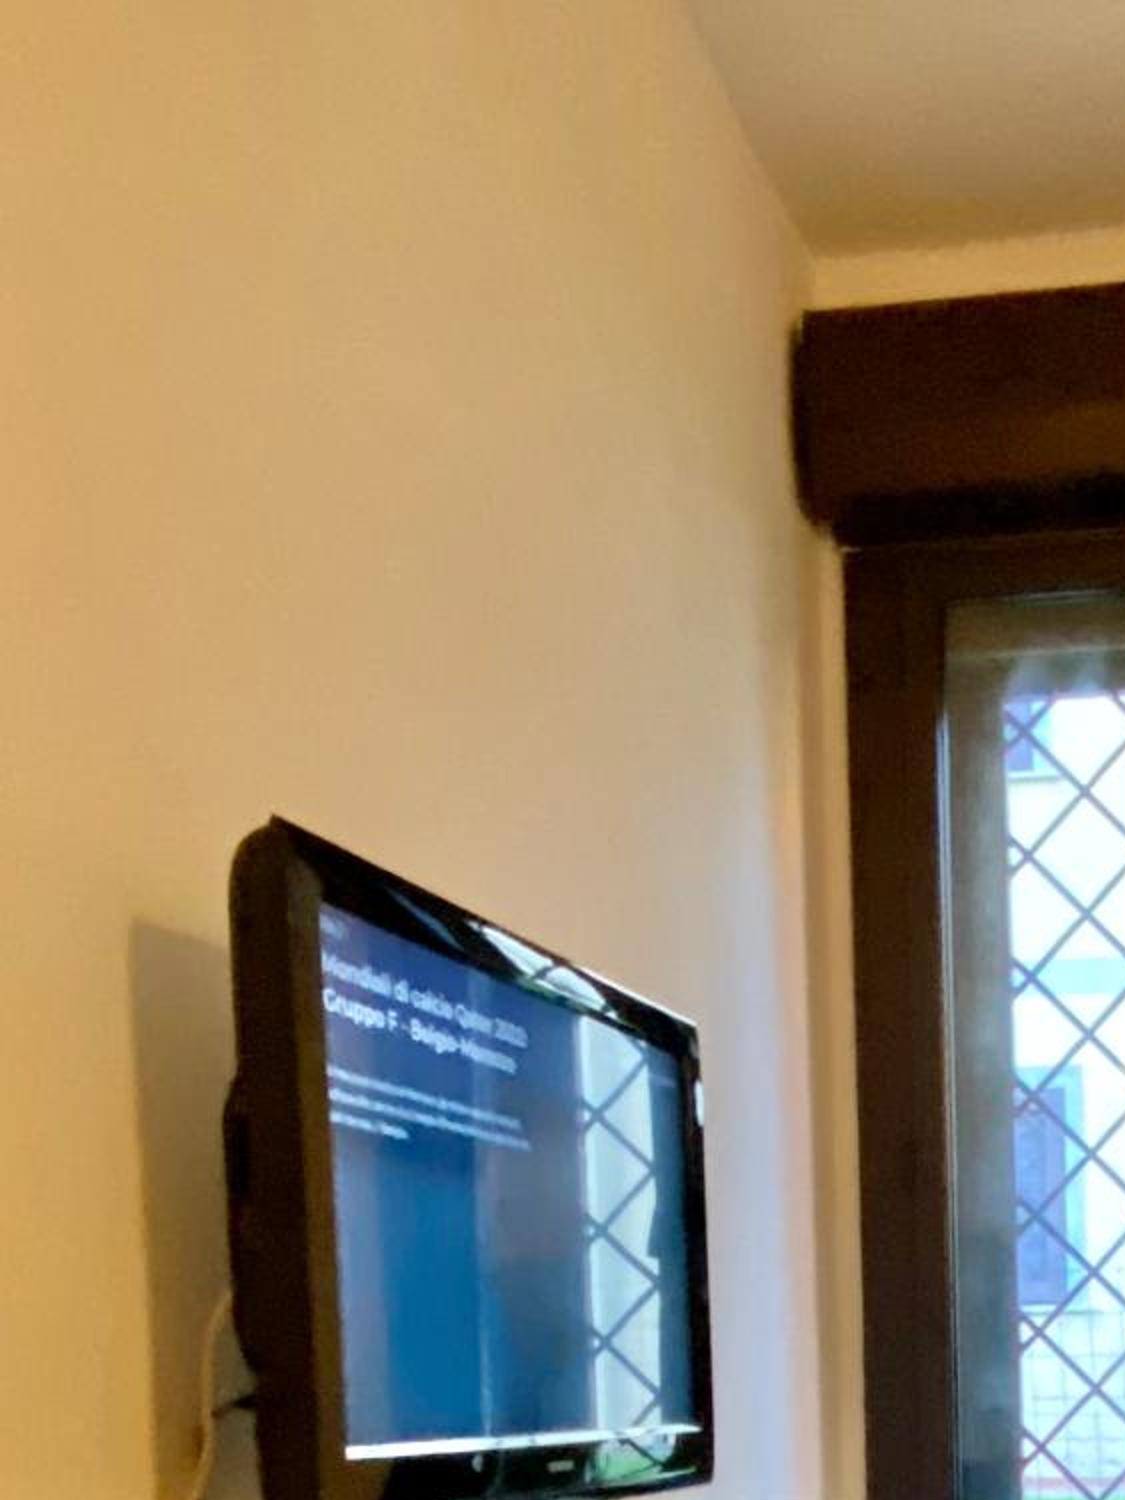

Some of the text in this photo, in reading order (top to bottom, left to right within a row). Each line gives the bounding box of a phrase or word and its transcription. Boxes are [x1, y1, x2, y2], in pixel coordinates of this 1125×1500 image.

[322, 987, 386, 1028] Gruppo
[387, 1008, 398, 1031] F
[410, 1017, 517, 1074] Belgio-M
